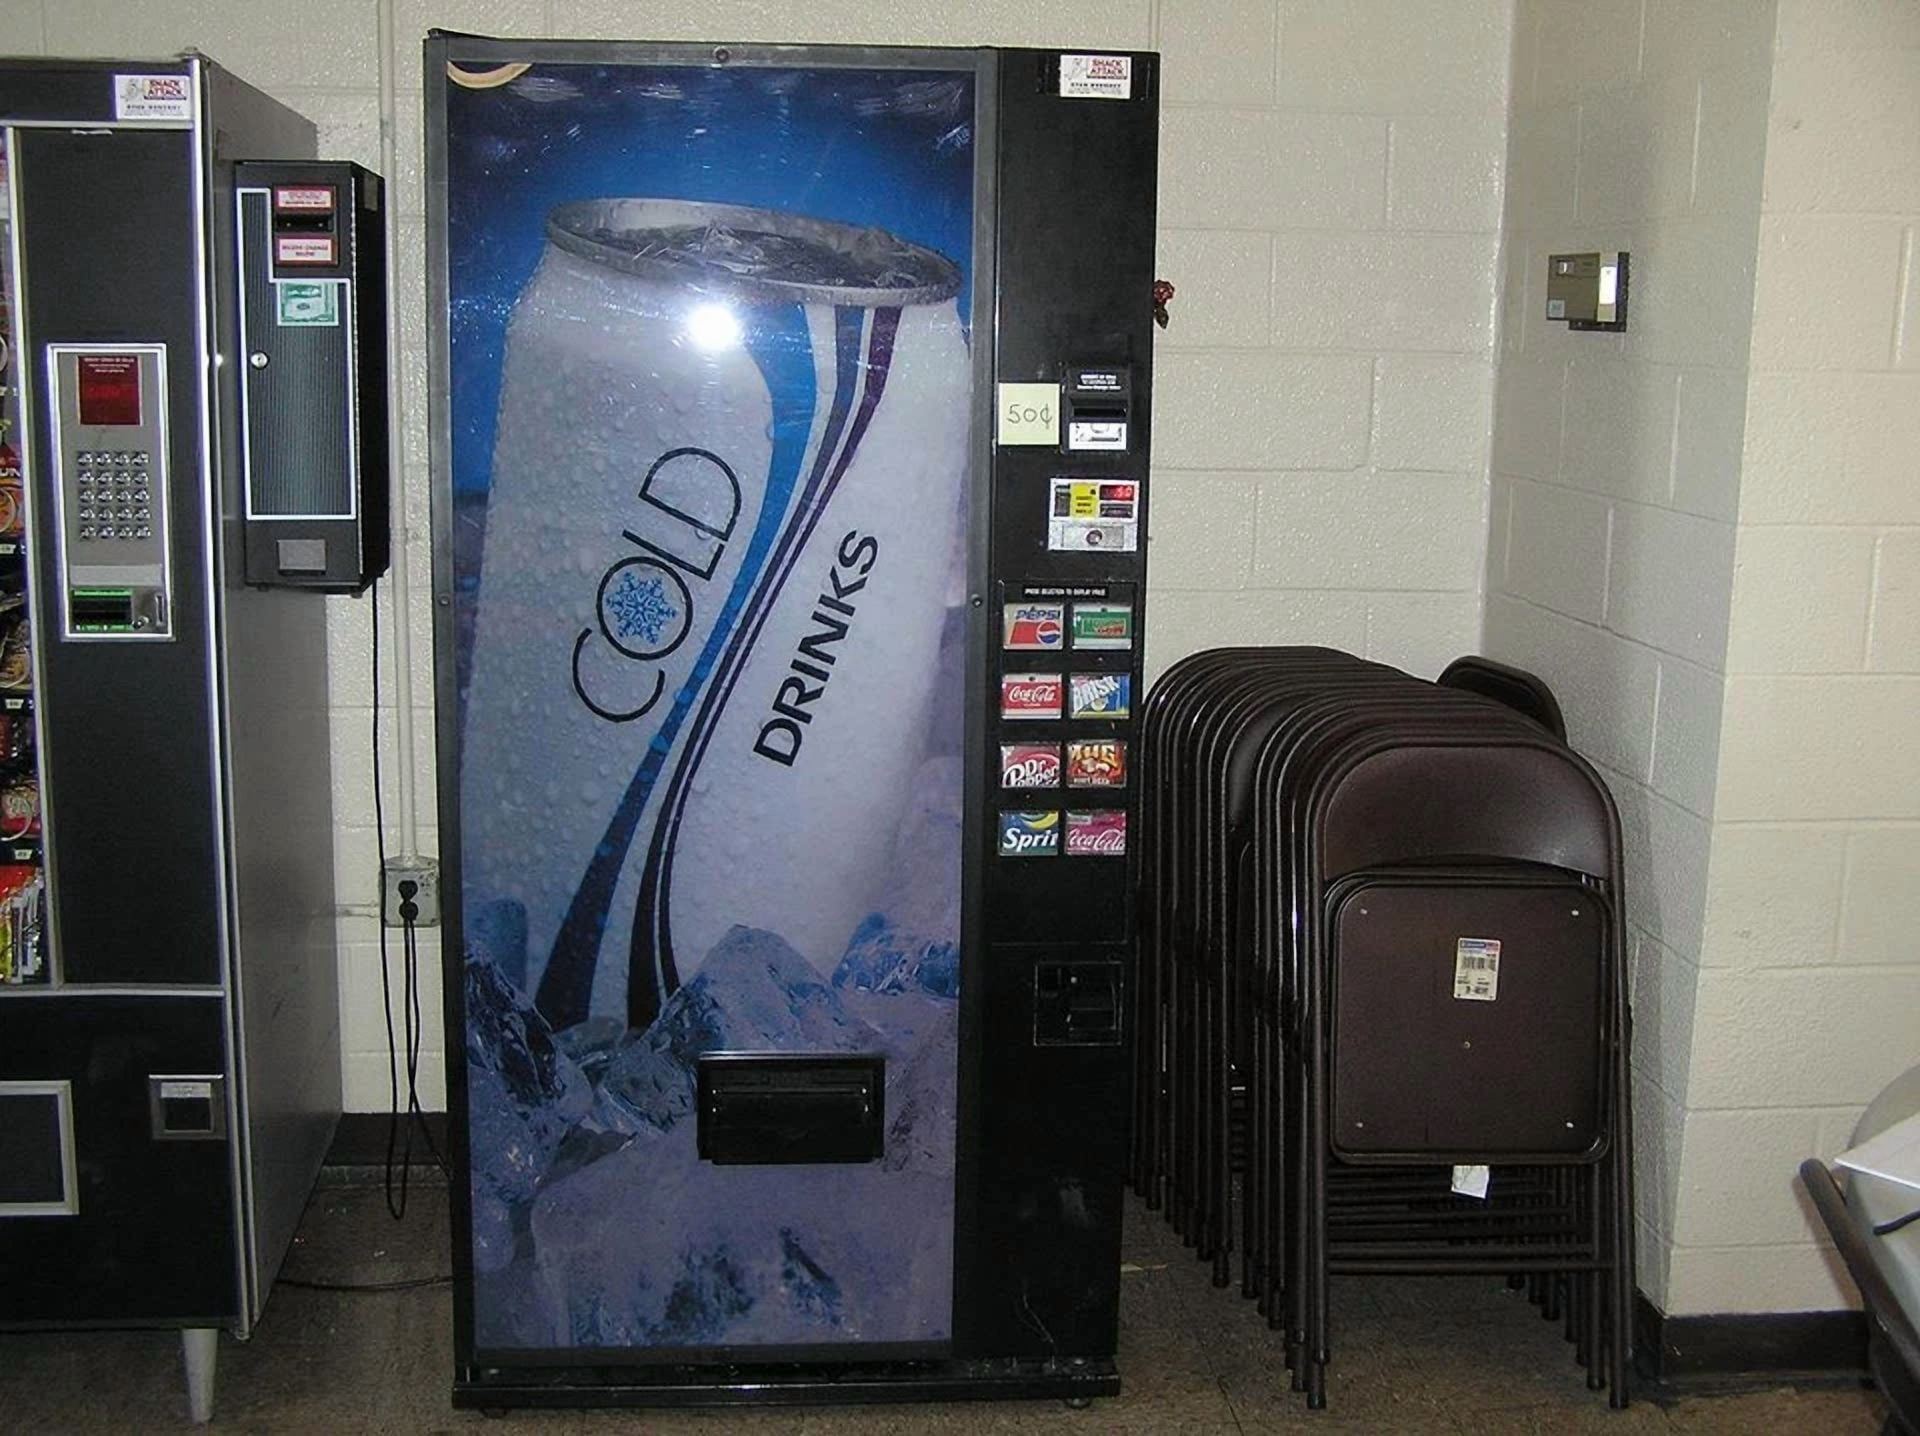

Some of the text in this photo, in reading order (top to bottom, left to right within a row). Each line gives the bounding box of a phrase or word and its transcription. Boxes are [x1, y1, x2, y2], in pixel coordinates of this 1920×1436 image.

[1090, 67, 1124, 75] ATTACK
[147, 87, 183, 96] ATTACK
[573, 447, 742, 723] COLD
[753, 530, 878, 767] DRINKS
[1073, 676, 1119, 714] BRISK
[1025, 759, 1047, 775] Dr
